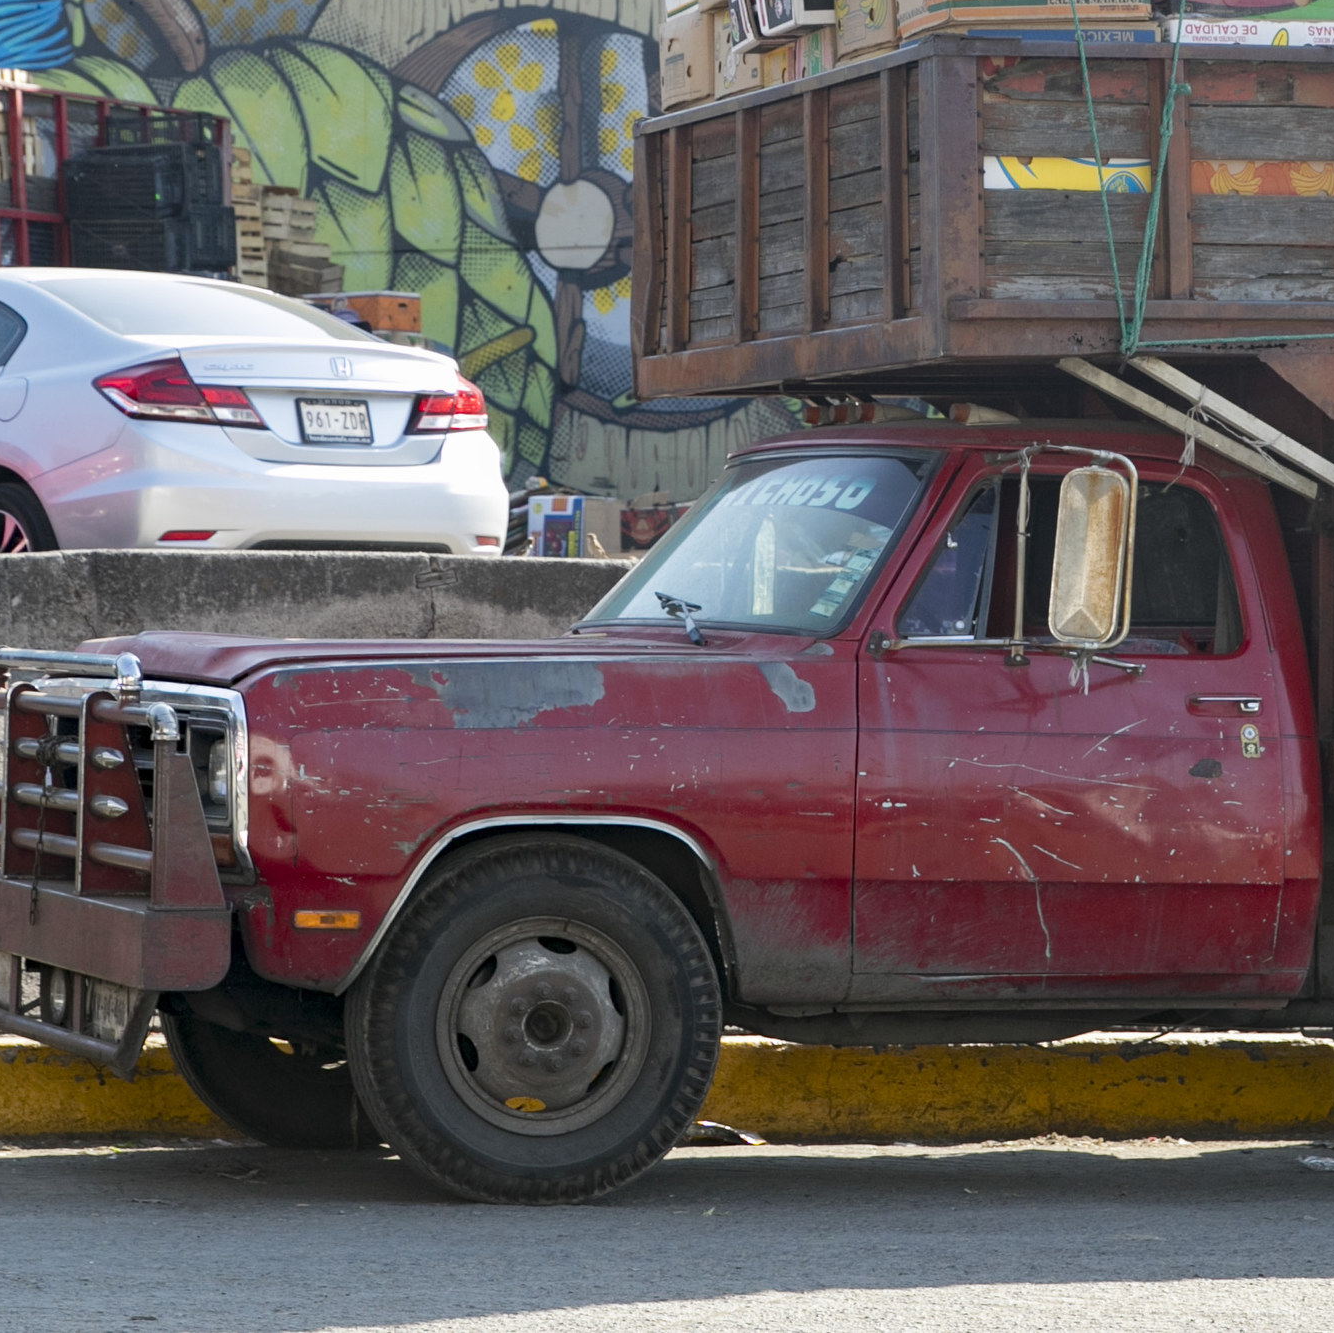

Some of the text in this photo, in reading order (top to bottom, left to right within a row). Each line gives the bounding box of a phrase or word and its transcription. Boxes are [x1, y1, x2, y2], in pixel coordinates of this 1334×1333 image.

[1185, 23, 1258, 35] DE CALIDAD
[1074, 30, 1135, 42] MEXICO
[305, 410, 368, 432] 961-ZDR
